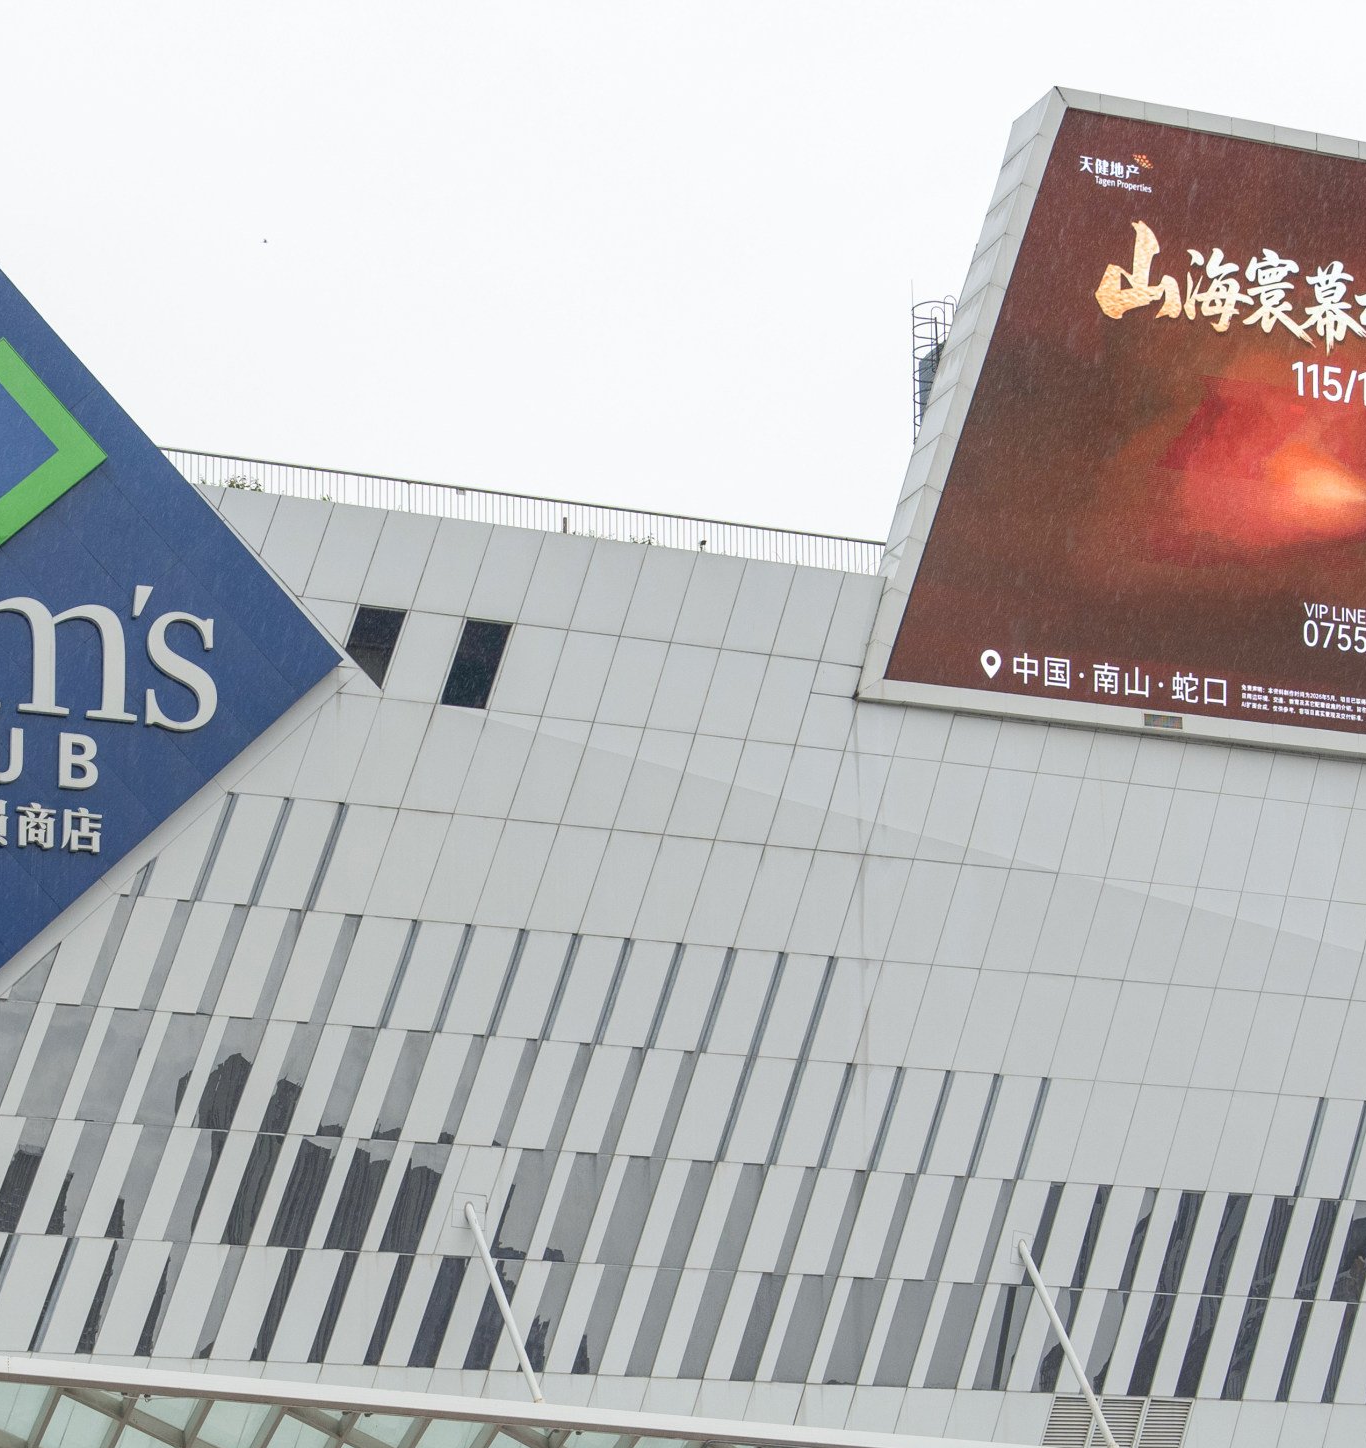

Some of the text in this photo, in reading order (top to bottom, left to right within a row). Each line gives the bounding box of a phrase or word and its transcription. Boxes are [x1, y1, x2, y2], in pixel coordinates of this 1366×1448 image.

[1079, 155, 1140, 180] 天健地产
[1095, 175, 1152, 193] Tagen Properties
[1304, 602, 1366, 625] VIP LINE
